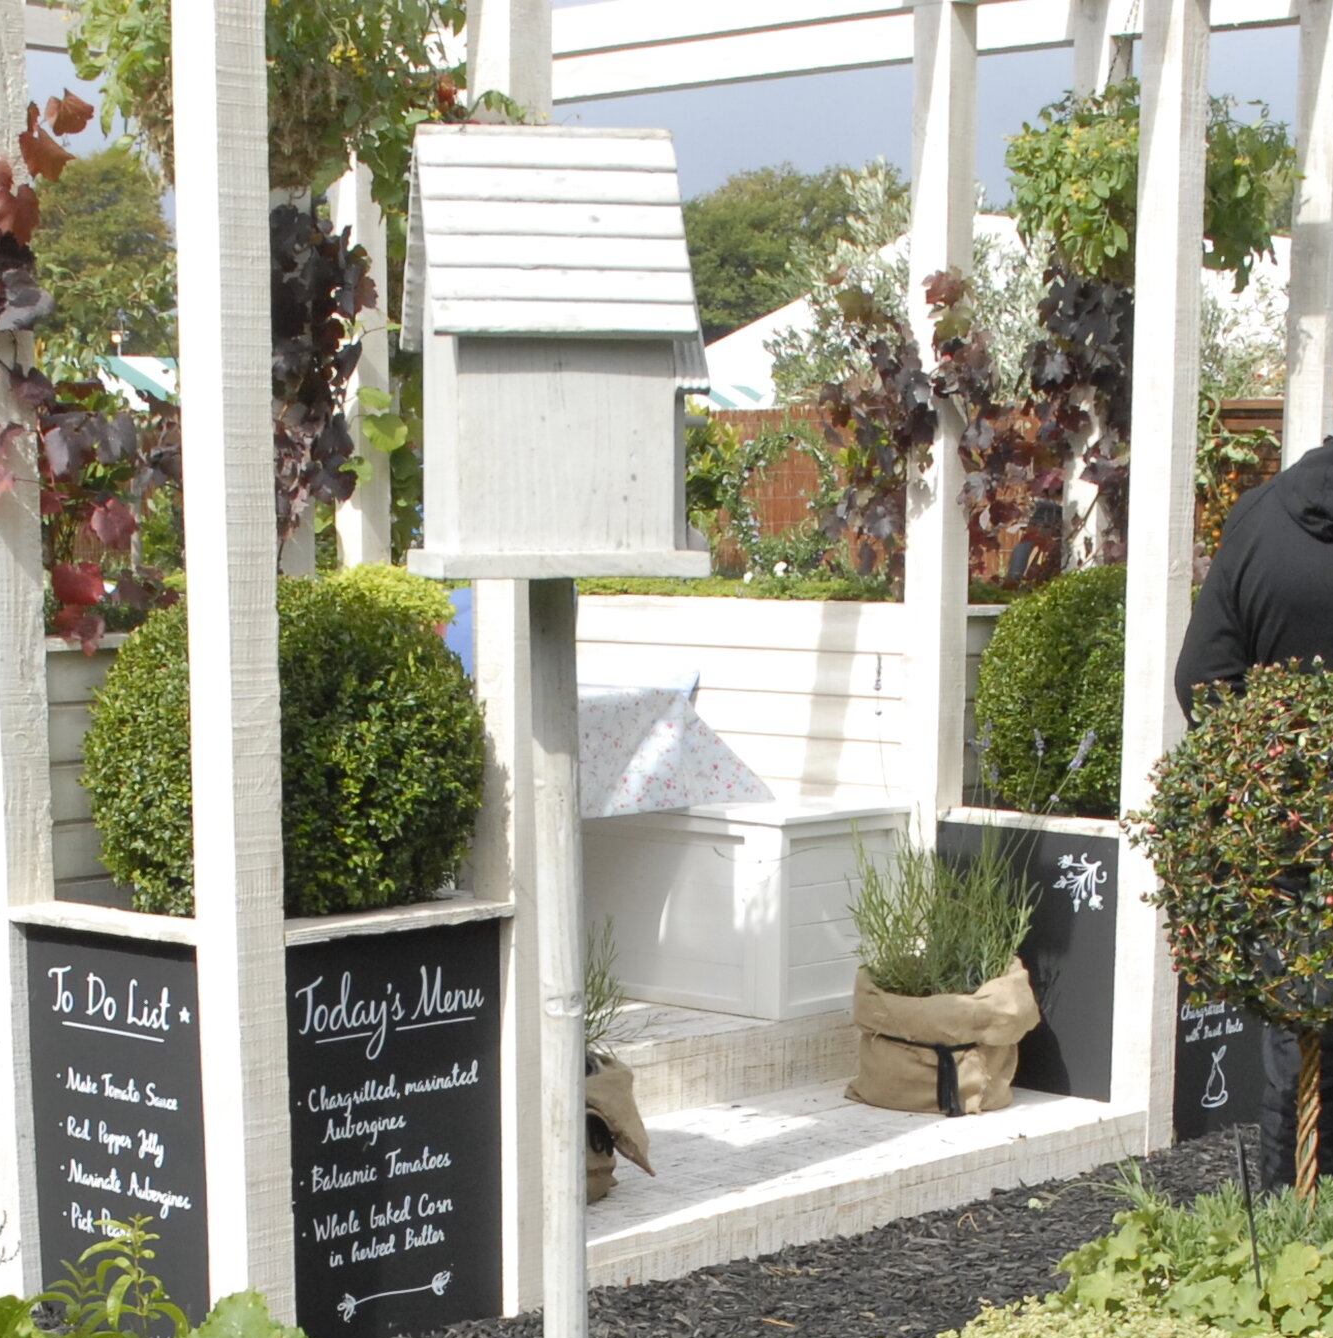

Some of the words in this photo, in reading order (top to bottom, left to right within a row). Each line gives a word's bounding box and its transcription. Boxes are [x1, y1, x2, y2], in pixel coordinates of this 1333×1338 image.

[47, 964, 74, 1013] To
[85, 972, 117, 1021] Do
[126, 978, 171, 1031] List
[295, 970, 406, 1061] Today's
[410, 964, 485, 1020] Menu
[65, 1066, 98, 1094] Make
[101, 1073, 141, 1103] Tomato
[145, 1082, 179, 1111] Sauce
[307, 1073, 401, 1116] Chargrilled,
[404, 1059, 479, 1096] marinated
[66, 1115, 92, 1141] Red
[97, 1120, 133, 1155] Pepper
[136, 1128, 165, 1168] Jelly
[320, 1113, 407, 1146] Aubergines
[67, 1158, 123, 1194] Marinate
[126, 1171, 193, 1220] Aubergines
[310, 1163, 378, 1193] Balsamic
[385, 1145, 452, 1179] Tomatoes
[70, 1201, 96, 1234] Pick
[312, 1208, 361, 1242] Whole
[369, 1195, 412, 1231] baked
[417, 1192, 454, 1217] Corn
[329, 1250, 344, 1268] in
[350, 1233, 397, 1263] herbed
[404, 1223, 446, 1251] Butter
